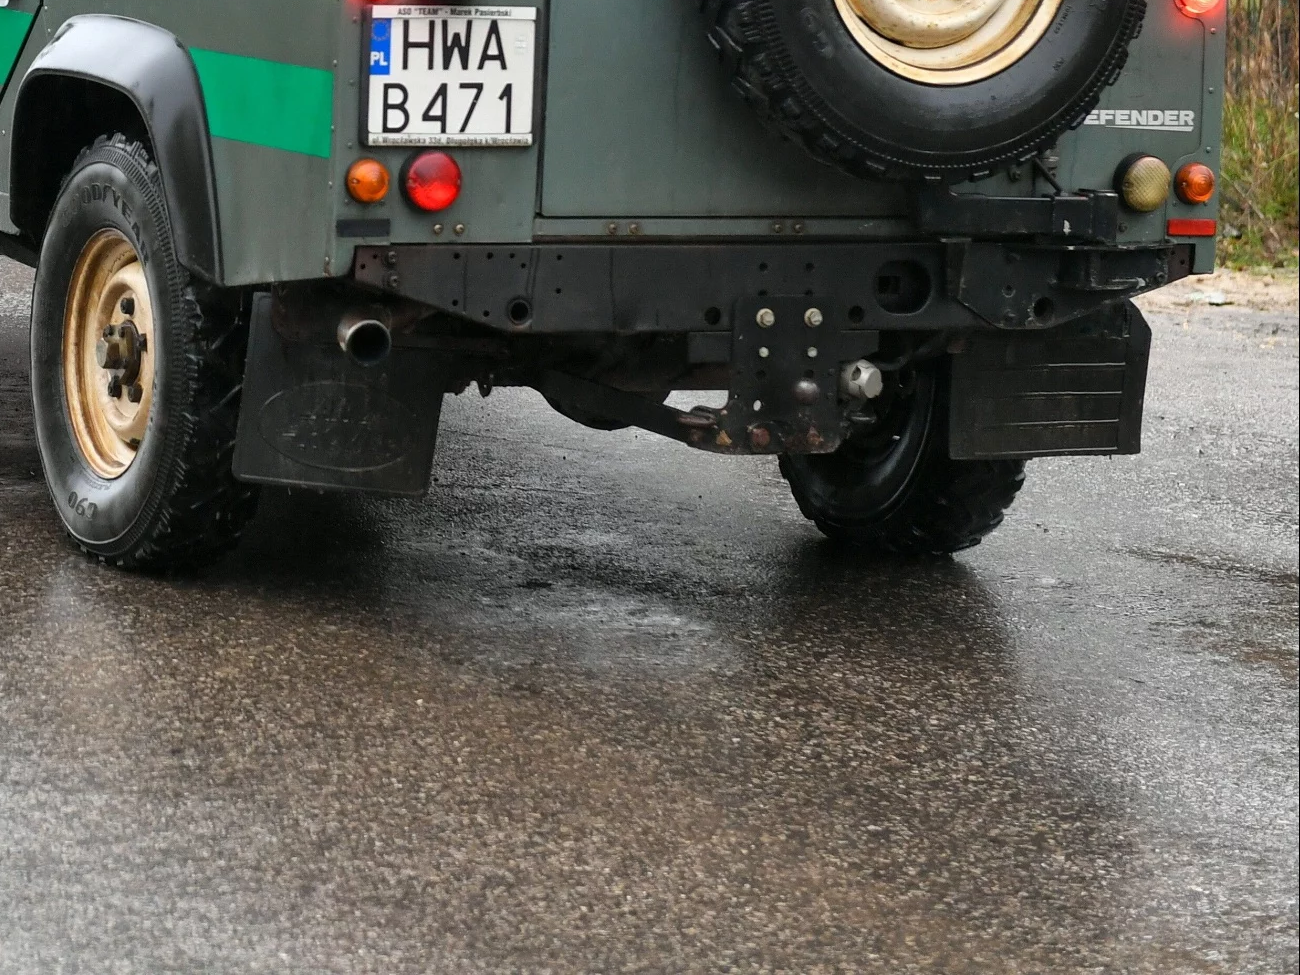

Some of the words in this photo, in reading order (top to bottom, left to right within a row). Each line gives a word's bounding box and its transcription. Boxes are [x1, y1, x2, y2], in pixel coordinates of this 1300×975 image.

[402, 20, 508, 70] HWA
[370, 52, 388, 66] PL
[1083, 109, 1196, 126] EFENDER
